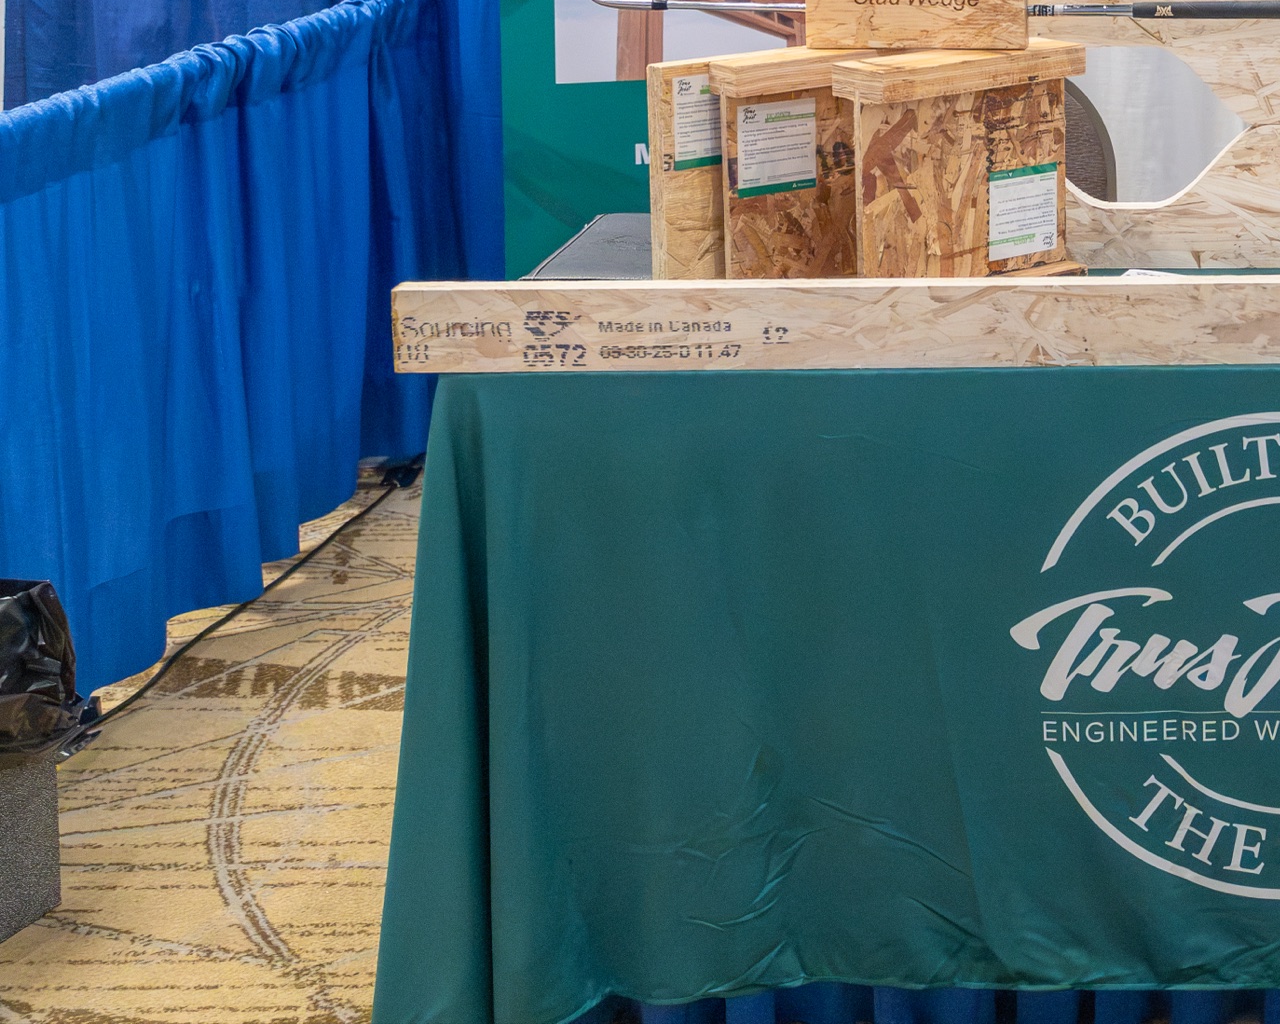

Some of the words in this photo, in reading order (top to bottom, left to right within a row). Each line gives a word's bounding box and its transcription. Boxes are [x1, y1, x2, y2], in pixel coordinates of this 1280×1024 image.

[598, 321, 644, 333] Made
[649, 321, 663, 332] in
[669, 320, 732, 332] Canada
[1043, 719, 1241, 743] ENGINEERED
[1129, 774, 1268, 876] THE
